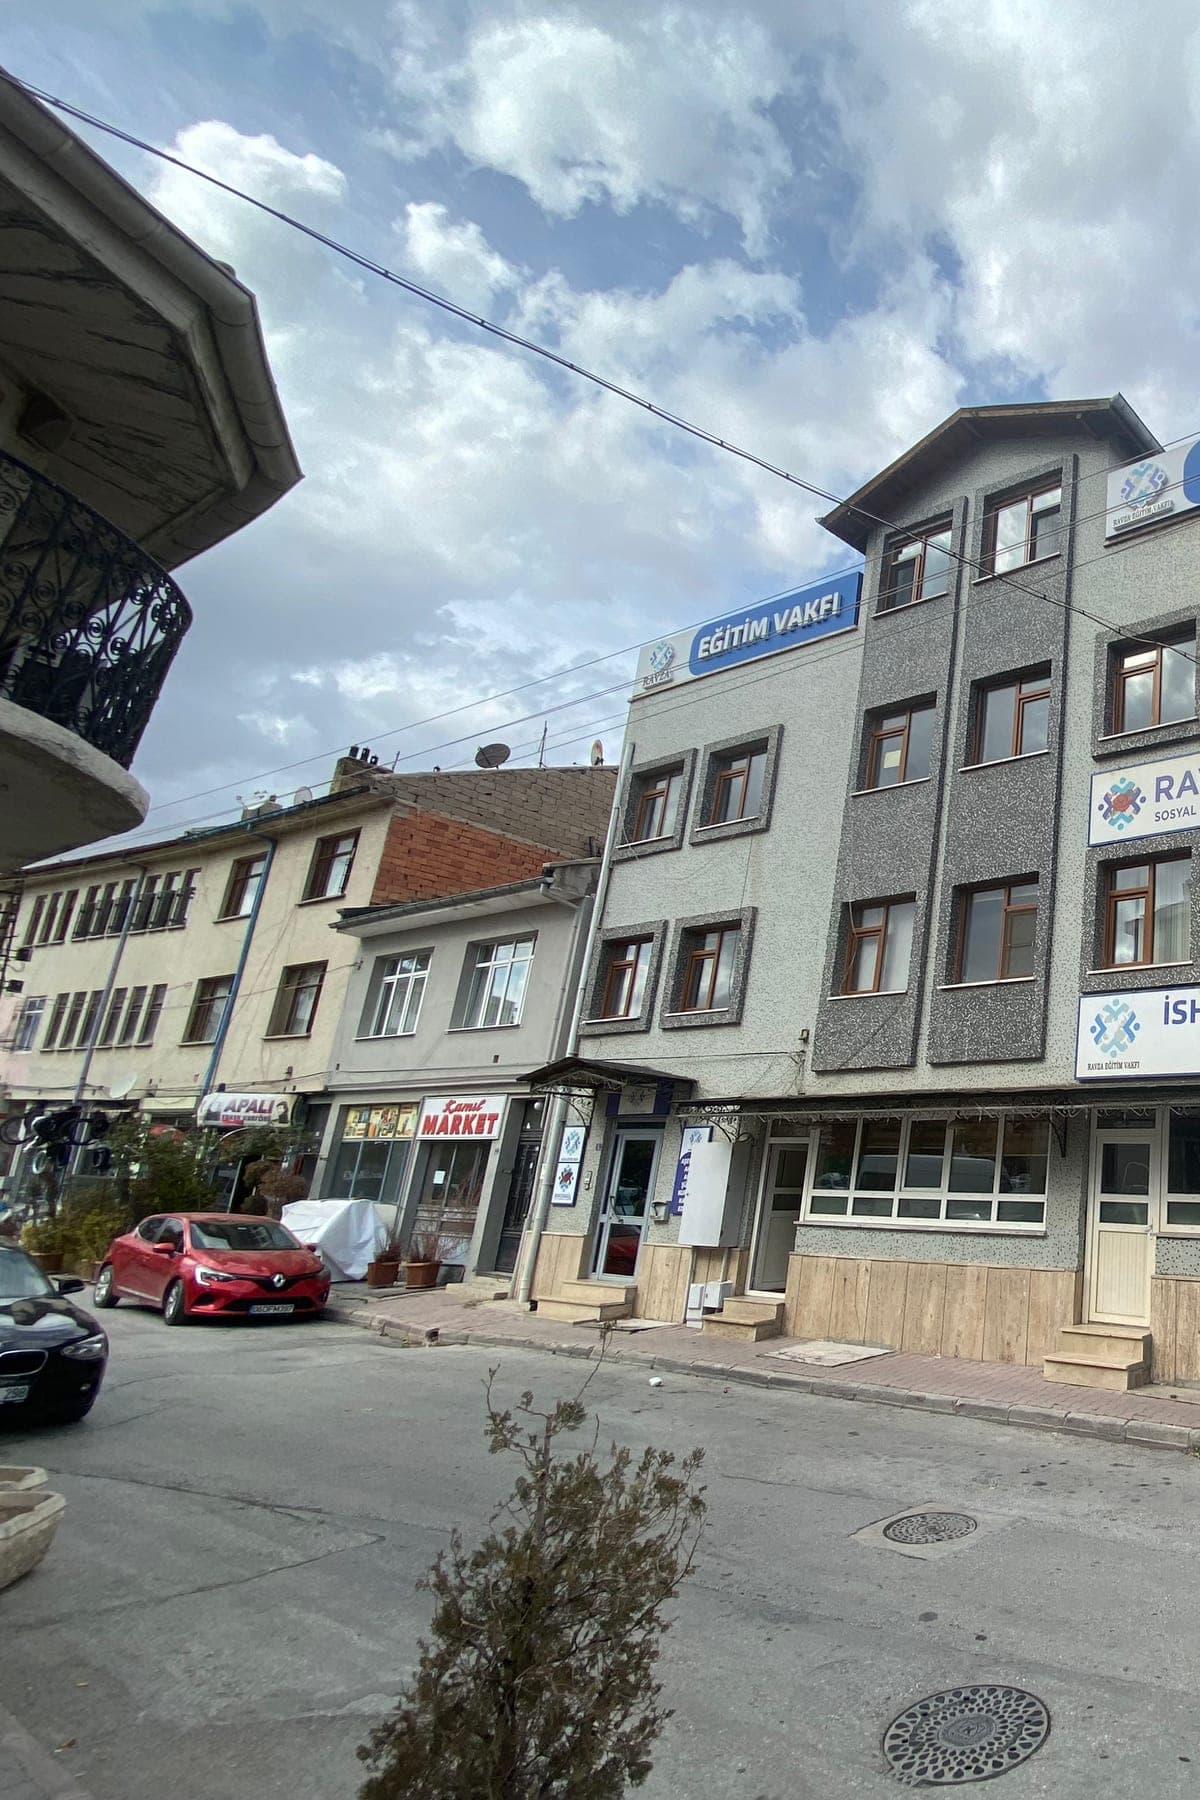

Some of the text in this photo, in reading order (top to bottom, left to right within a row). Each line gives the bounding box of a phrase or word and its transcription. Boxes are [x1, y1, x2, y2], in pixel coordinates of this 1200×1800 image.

[698, 592, 842, 660] EĞİTİM VAKFI
[1154, 806, 1197, 822] SOSYAL
[421, 1113, 499, 1135] MARKET
